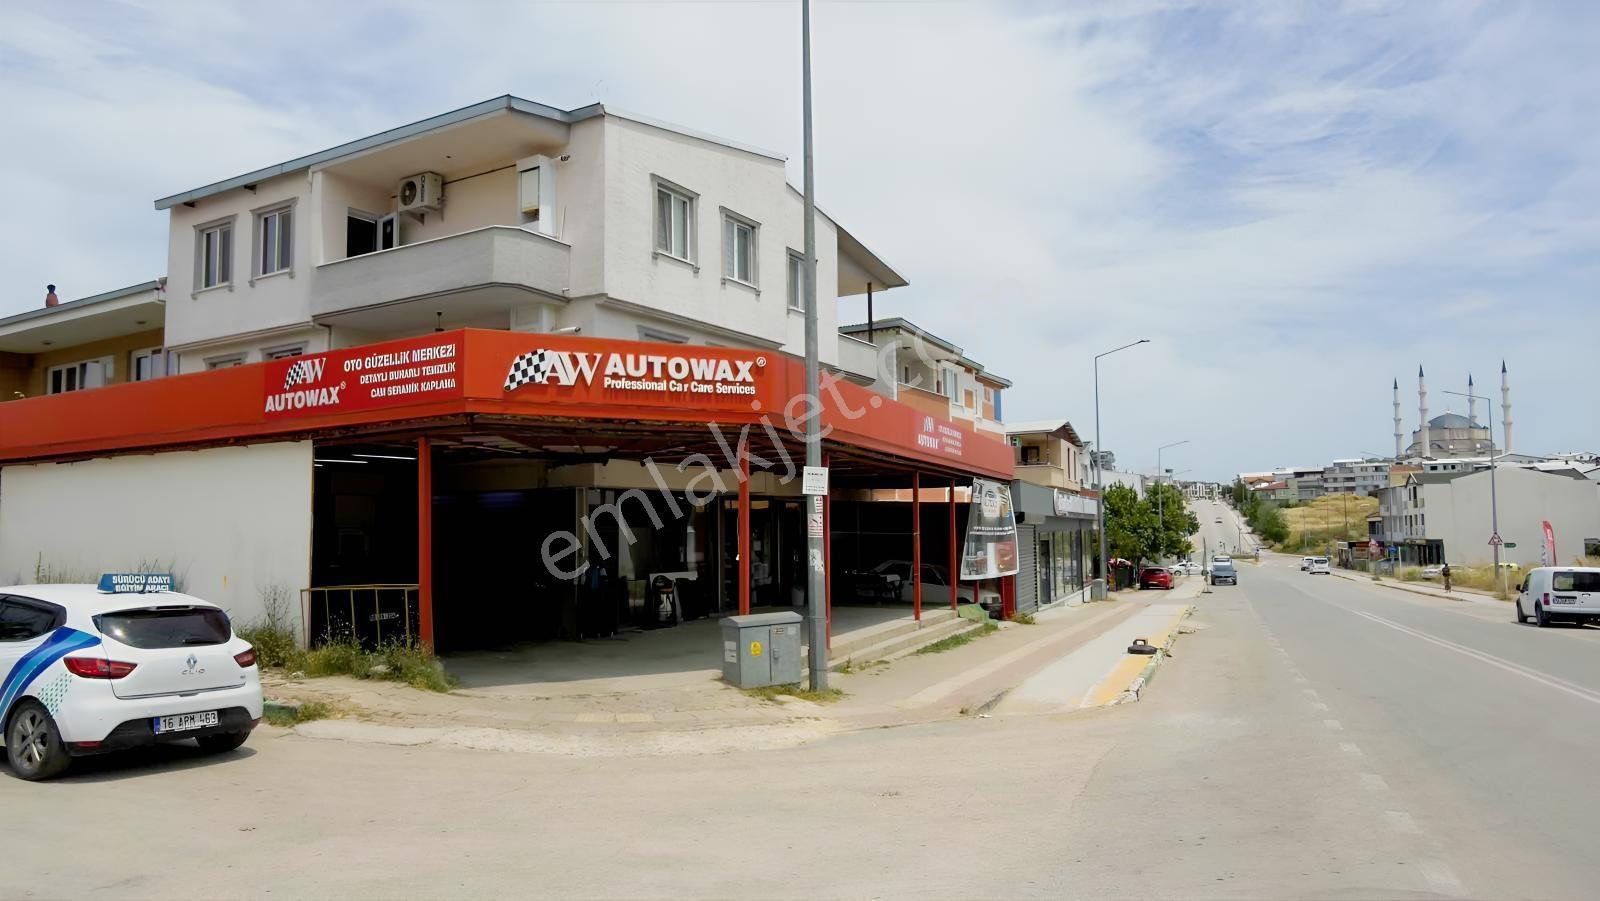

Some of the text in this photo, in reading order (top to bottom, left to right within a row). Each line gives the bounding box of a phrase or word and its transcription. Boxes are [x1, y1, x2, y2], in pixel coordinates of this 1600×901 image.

[604, 352, 754, 382] AUTOWAX
[604, 377, 756, 395] Professional Car Care Services
[162, 718, 174, 729] 16
